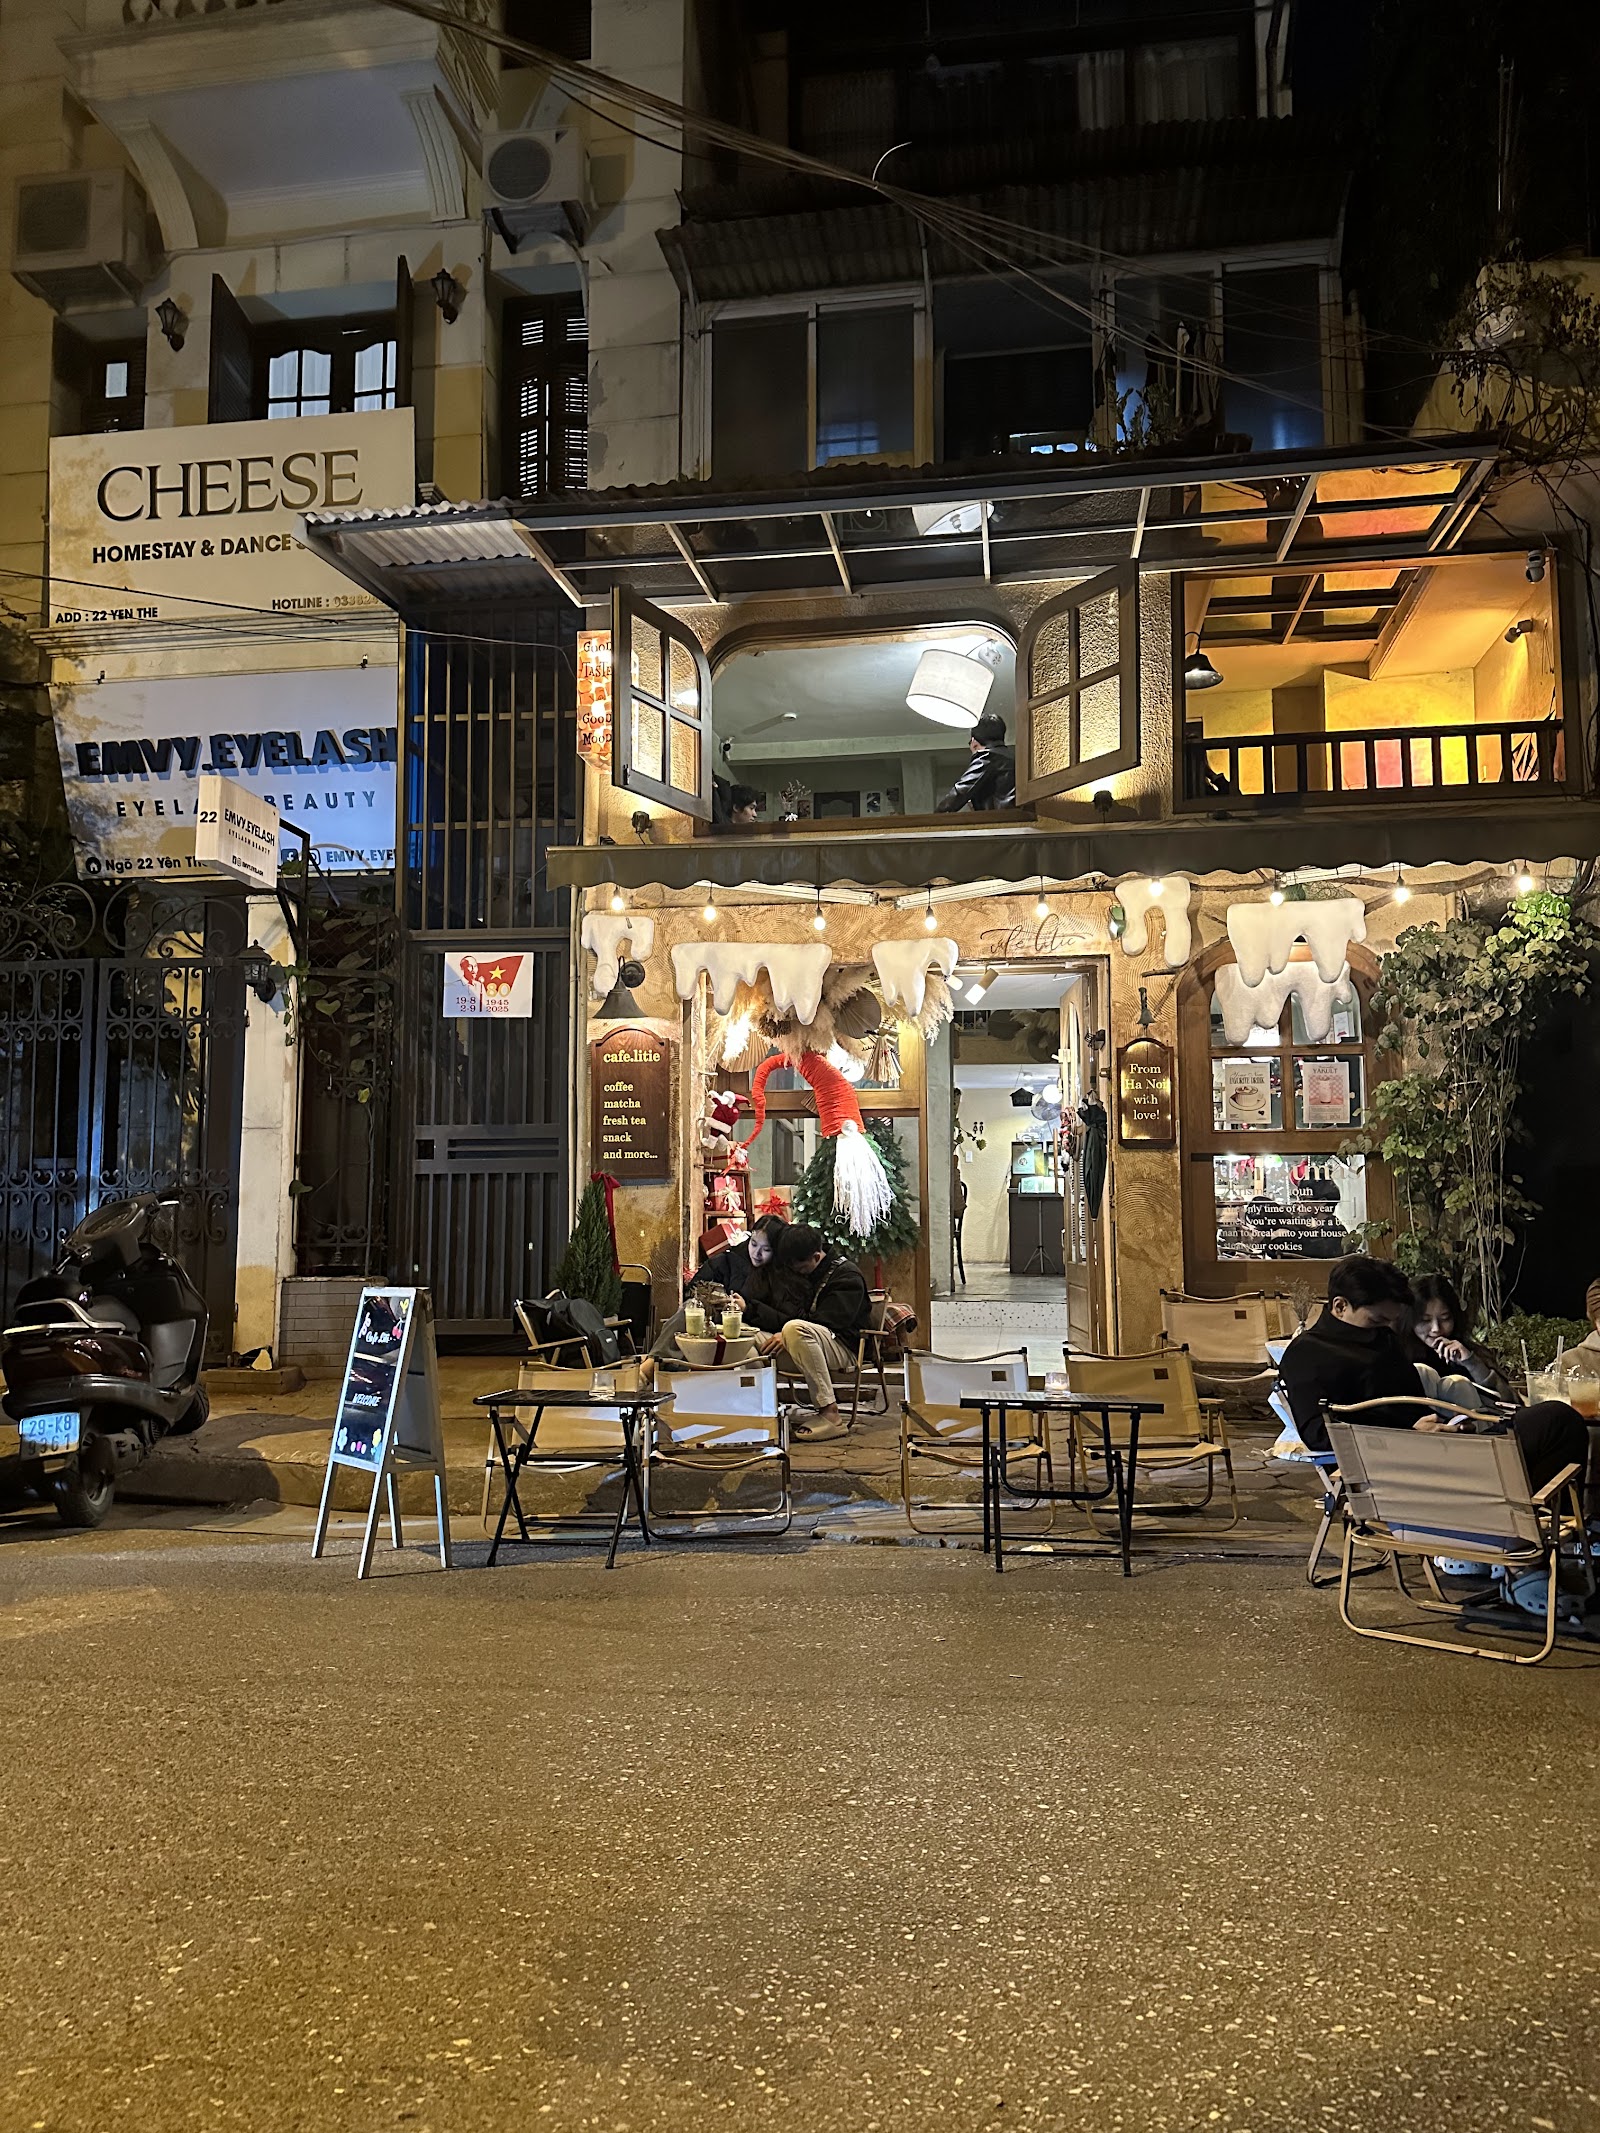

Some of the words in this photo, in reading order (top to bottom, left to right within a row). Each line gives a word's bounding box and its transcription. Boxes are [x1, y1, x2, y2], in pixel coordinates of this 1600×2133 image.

[97, 450, 364, 522] CHEESE
[92, 540, 196, 564] HOMESTAY
[201, 539, 215, 556] &
[221, 533, 291, 556] DANCE
[272, 597, 322, 610] HOTLINE
[56, 612, 81, 623] ADD
[92, 610, 107, 621] 22
[111, 608, 133, 620] YEN
[137, 607, 158, 618] THE
[75, 727, 398, 777] EMVY.EYELASH
[264, 791, 375, 810] BEAUTY
[199, 811, 217, 823] 22
[224, 808, 275, 846] EMVY.EYELASH
[326, 849, 396, 863] EMVY.EYE
[137, 858, 153, 869] 22
[157, 856, 181, 869] Yên
[486, 982, 511, 997] 80
[603, 1049, 661, 1063] cafe.litie
[1129, 1063, 1161, 1074] From
[603, 1081, 634, 1092] coffee
[1124, 1079, 1142, 1089] Ha
[1145, 1078, 1167, 1089] Noi
[603, 1098, 641, 1109] matcha
[1133, 1094, 1158, 1104] with
[602, 1115, 628, 1126] fresh
[631, 1116, 646, 1125] tea
[1133, 1109, 1160, 1120] love!
[602, 1132, 633, 1142] snack
[603, 1149, 622, 1159] and
[624, 1151, 658, 1159] more...
[1264, 1204, 1284, 1213] time
[1286, 1204, 1297, 1213] of
[1297, 1204, 1312, 1213] the
[1314, 1207, 1334, 1215] year
[1278, 1216, 1311, 1227] waiting
[1240, 1229, 1250, 1237] to
[1298, 1230, 1319, 1239] your
[1320, 1229, 1347, 1238] house
[1268, 1241, 1303, 1251] cookies
[352, 1393, 382, 1407] WELCOME
[29, 1414, 71, 1437] 29-K8
